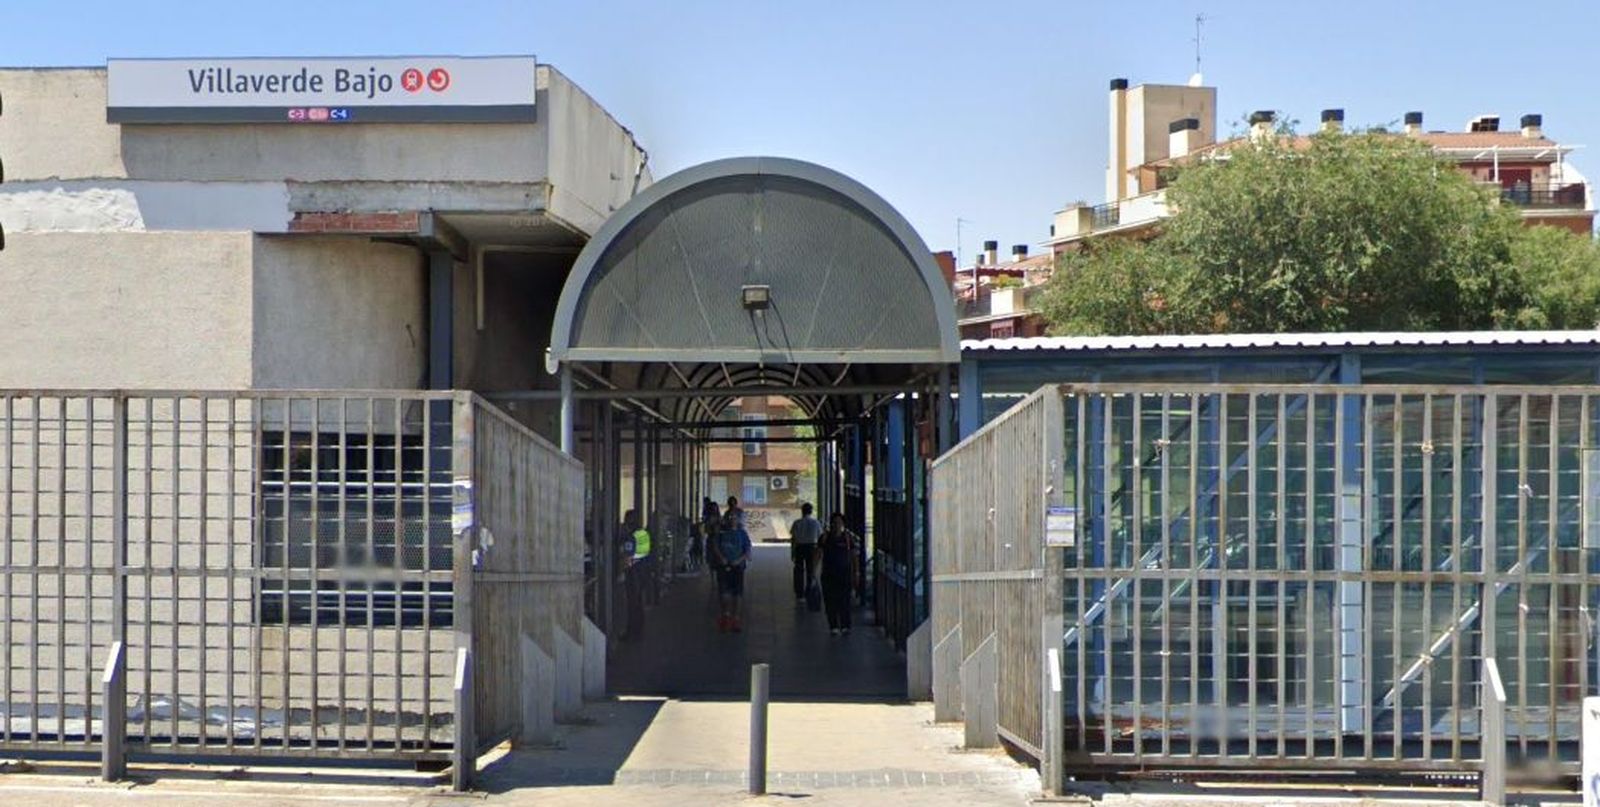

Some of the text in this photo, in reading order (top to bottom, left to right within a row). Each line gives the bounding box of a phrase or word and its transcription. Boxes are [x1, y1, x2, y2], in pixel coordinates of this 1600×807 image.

[188, 67, 393, 99] Villaverde Bajo
[330, 109, 347, 119] C-4
